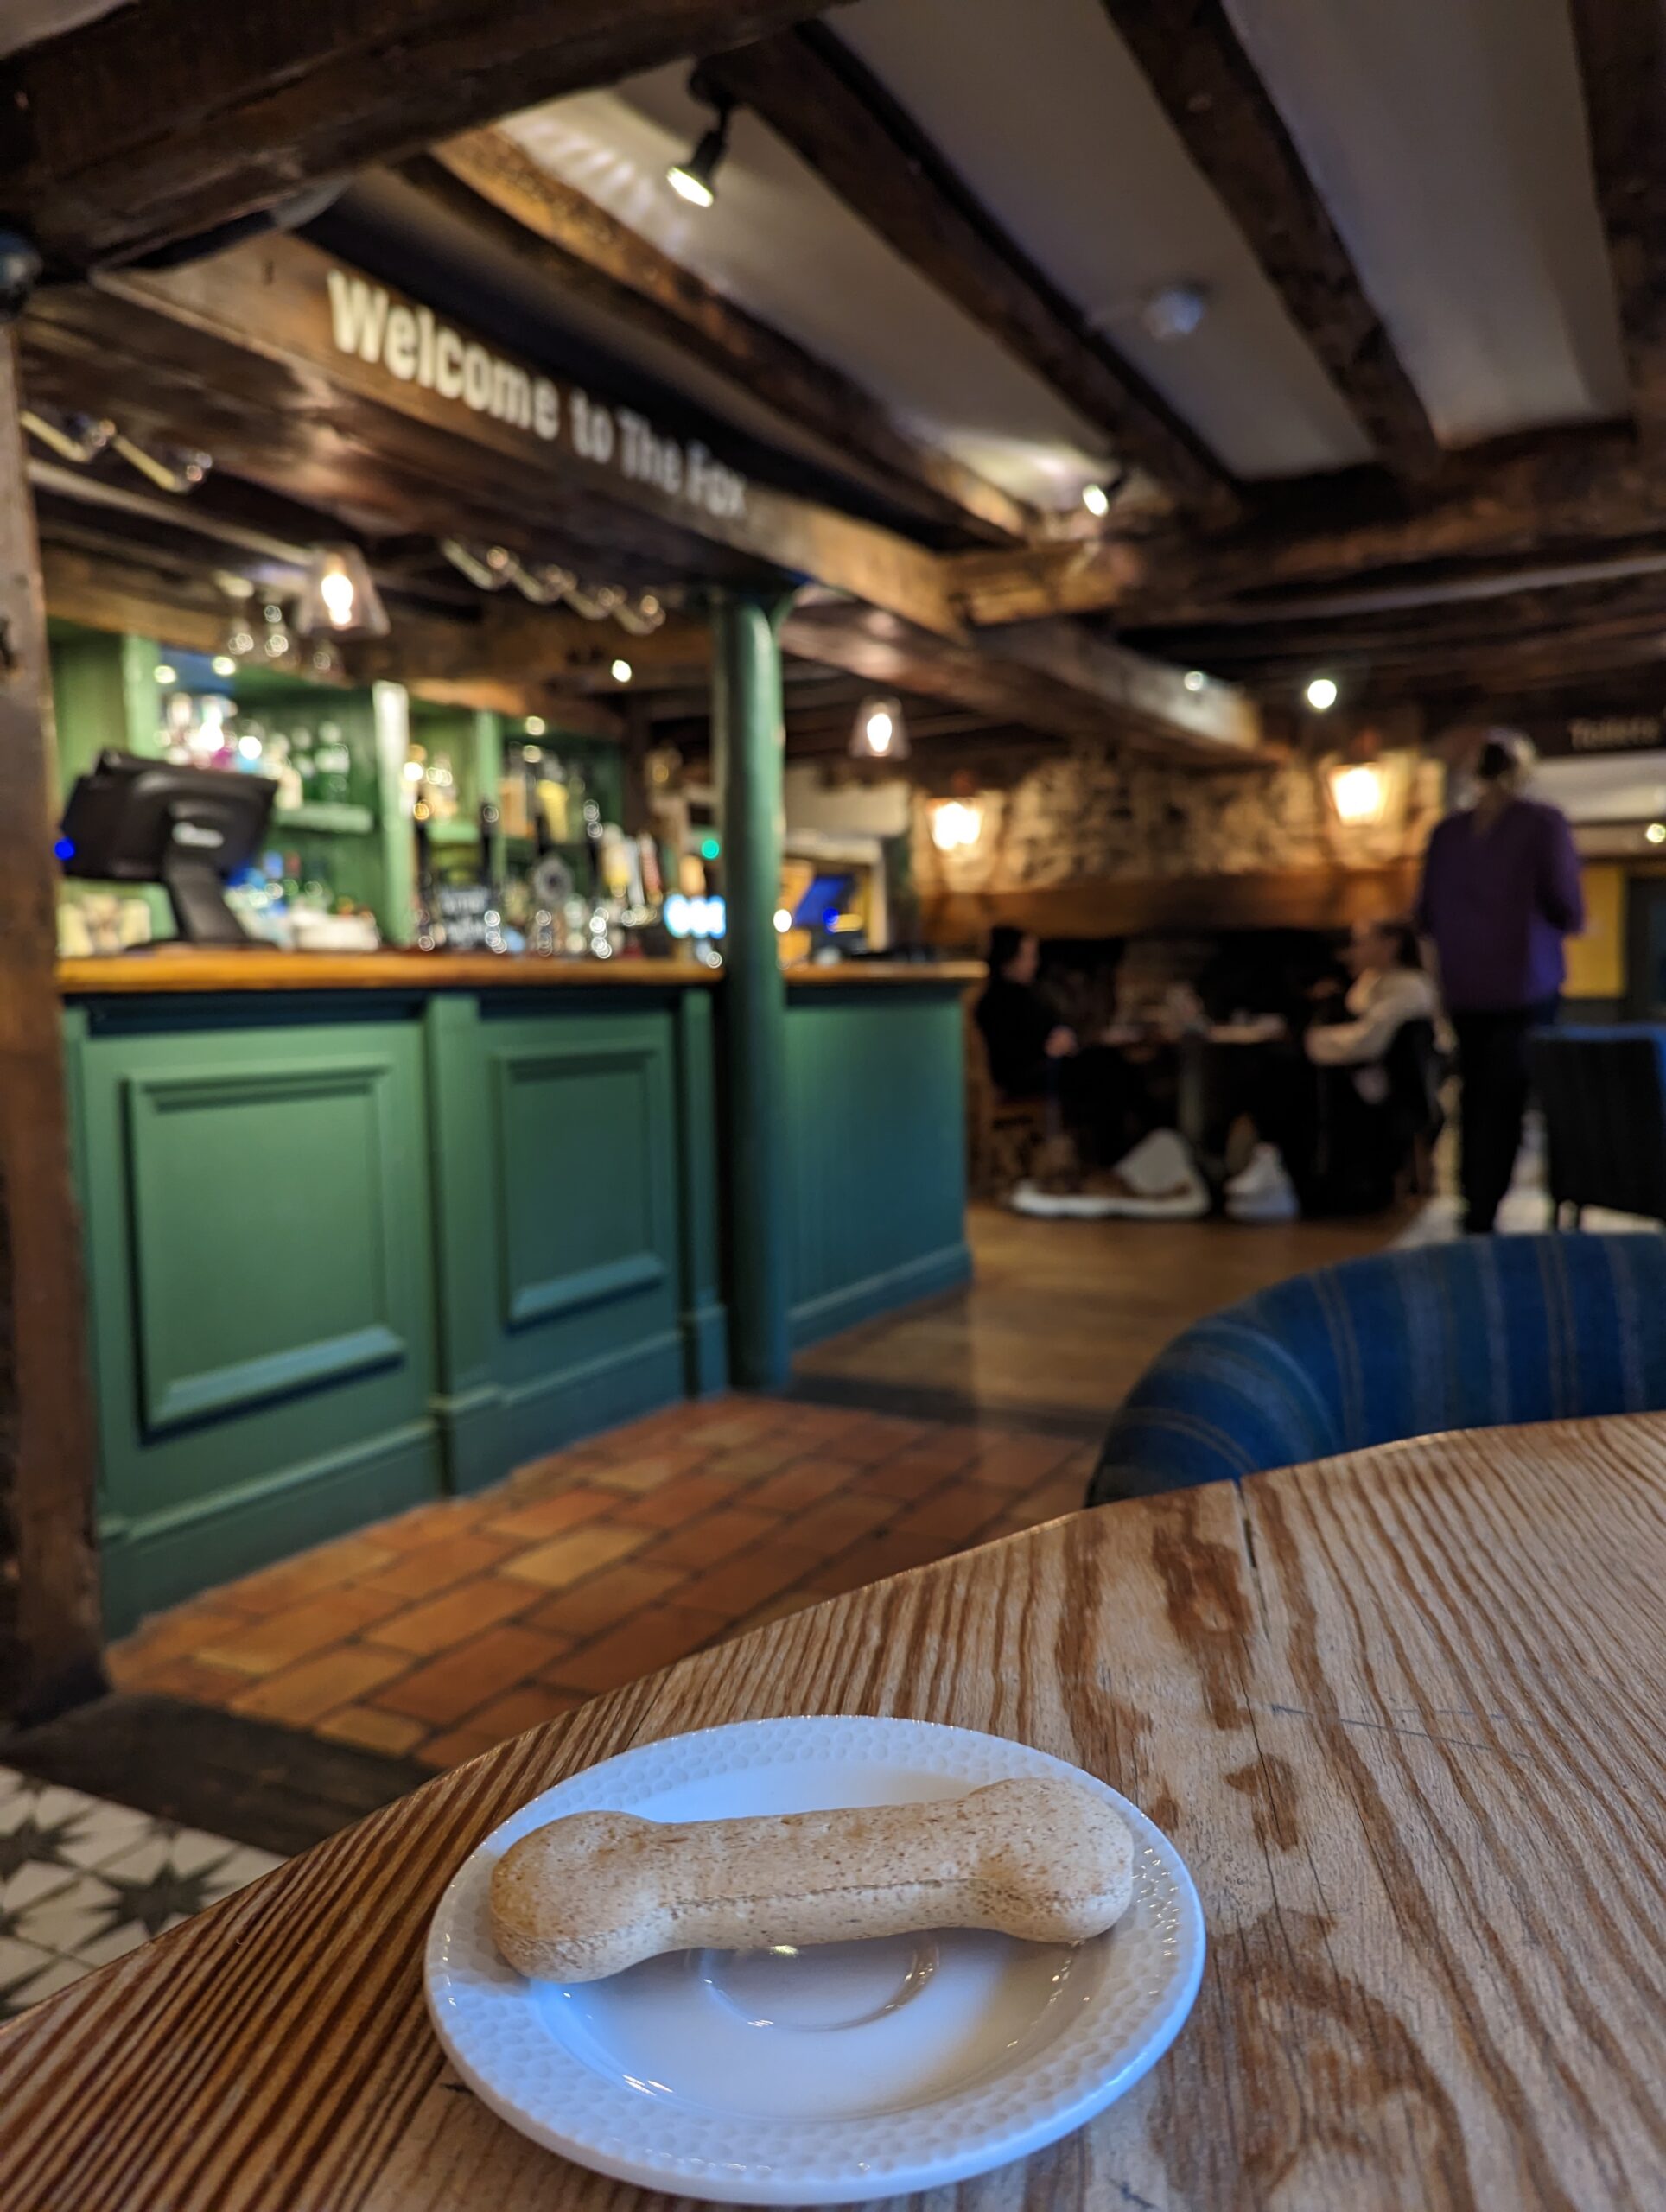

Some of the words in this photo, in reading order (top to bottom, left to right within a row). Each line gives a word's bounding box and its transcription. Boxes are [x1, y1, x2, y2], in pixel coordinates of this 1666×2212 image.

[327, 270, 559, 440] Welcome
[569, 388, 614, 464] to
[618, 408, 683, 495] The
[685, 439, 747, 518] Fox
